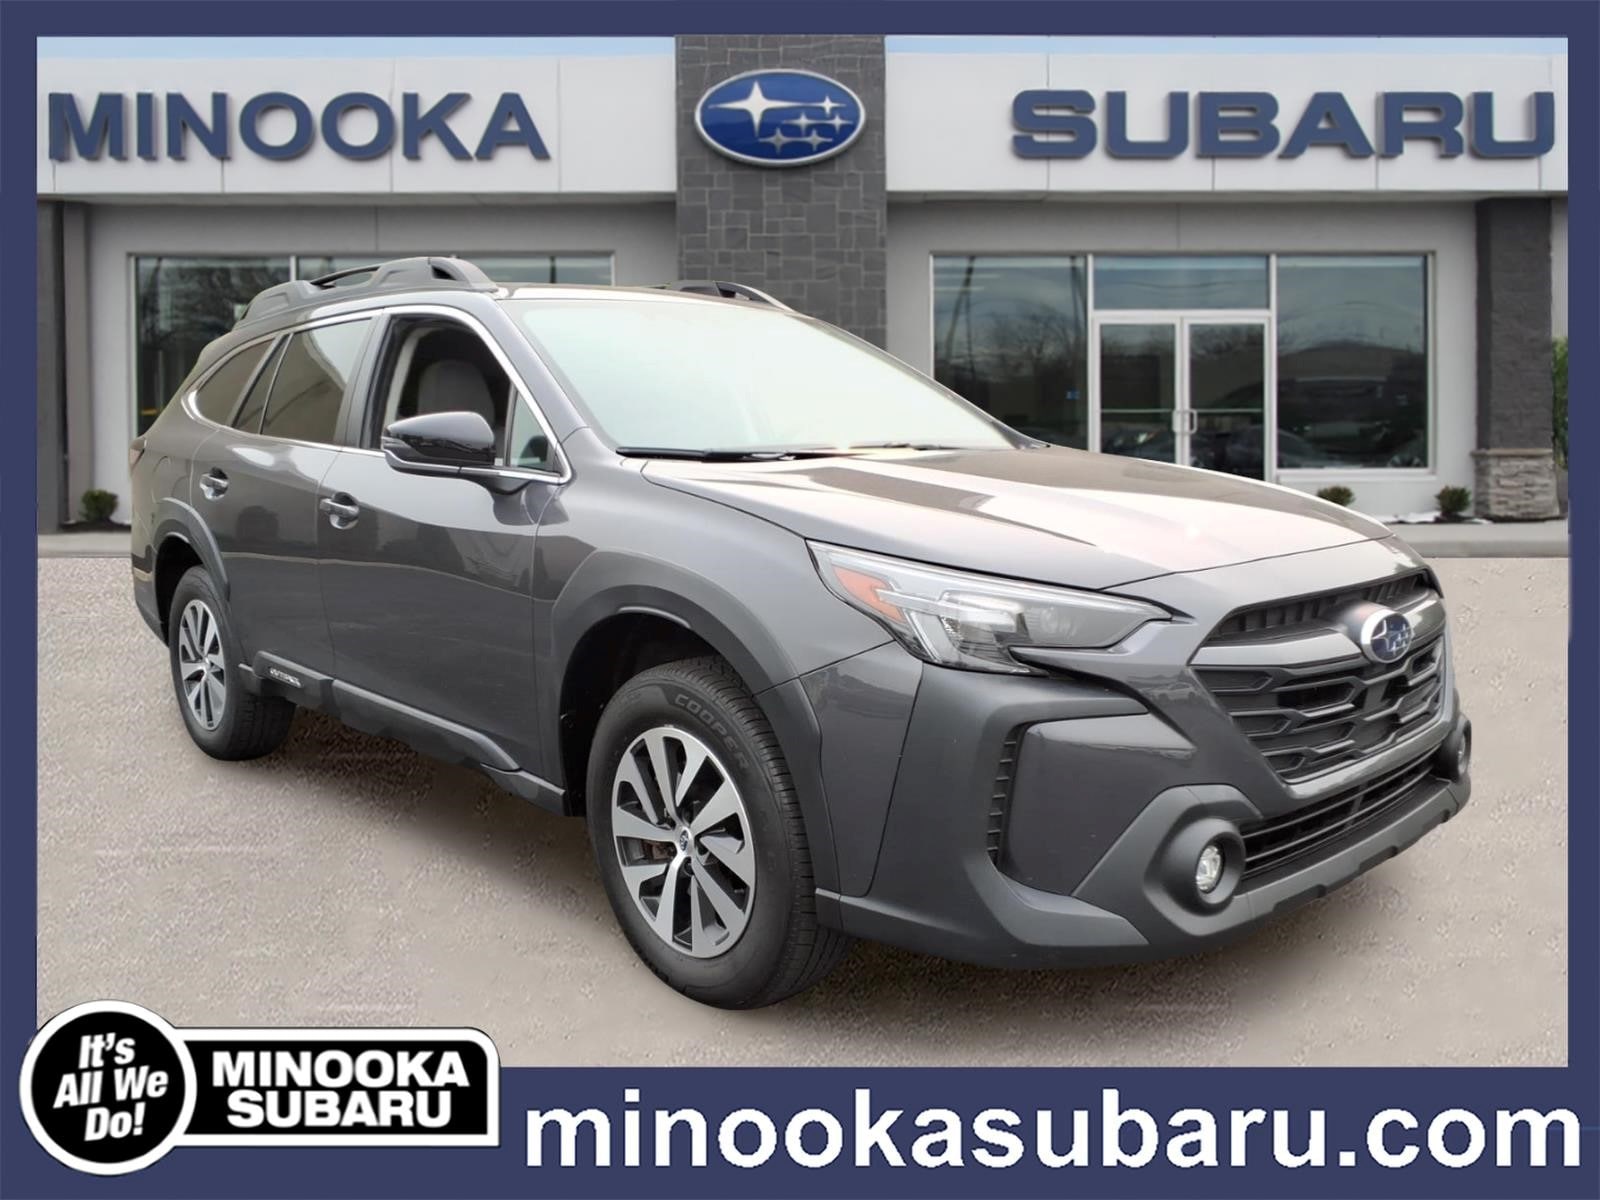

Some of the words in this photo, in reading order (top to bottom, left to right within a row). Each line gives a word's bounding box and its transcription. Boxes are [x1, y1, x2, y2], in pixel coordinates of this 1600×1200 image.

[48, 92, 550, 164] MINOOKA
[1012, 89, 1556, 161] SUBARU
[674, 693, 750, 769] COOPER
